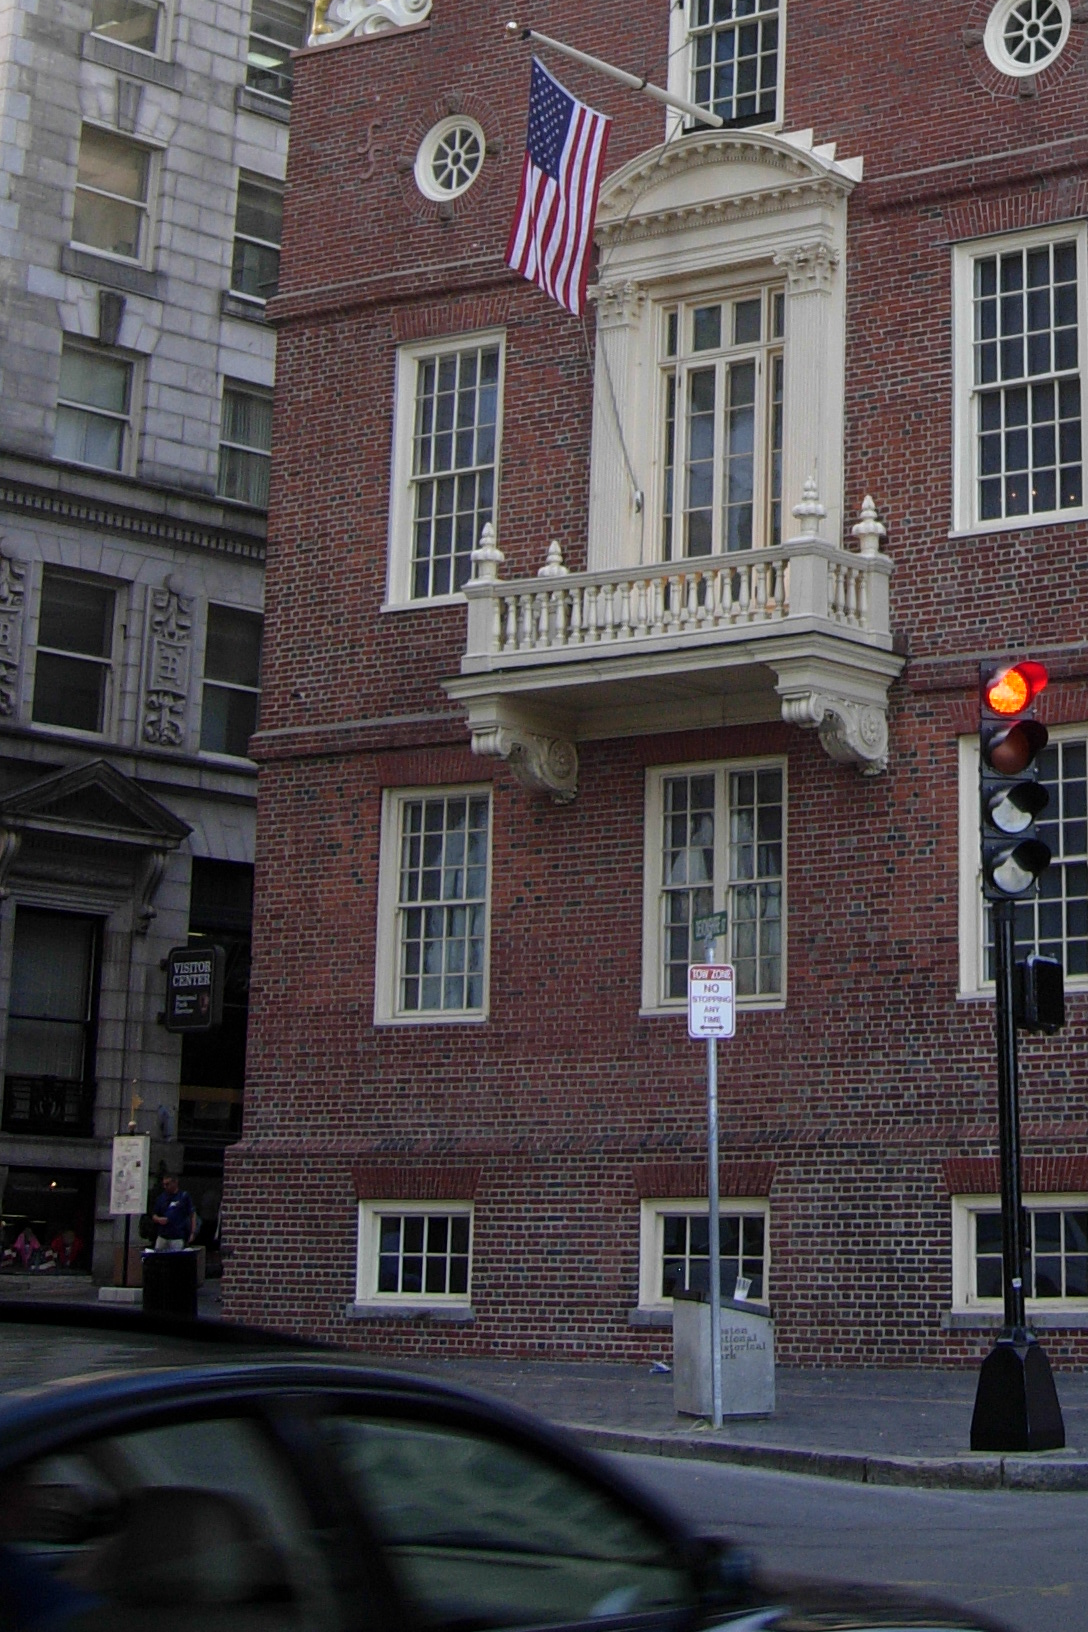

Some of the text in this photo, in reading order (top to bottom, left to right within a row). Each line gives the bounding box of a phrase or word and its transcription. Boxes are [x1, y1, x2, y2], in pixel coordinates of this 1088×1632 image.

[174, 961, 211, 973] VISITOR
[692, 969, 731, 980] TOW ZONE
[173, 974, 210, 986] CENTER
[704, 984, 720, 994] NO
[692, 996, 732, 1004] STOPPING
[704, 1016, 721, 1024] TIME
[720, 1334, 757, 1342] ational
[720, 1342, 766, 1351] istorical
[721, 1350, 736, 1359] ark
